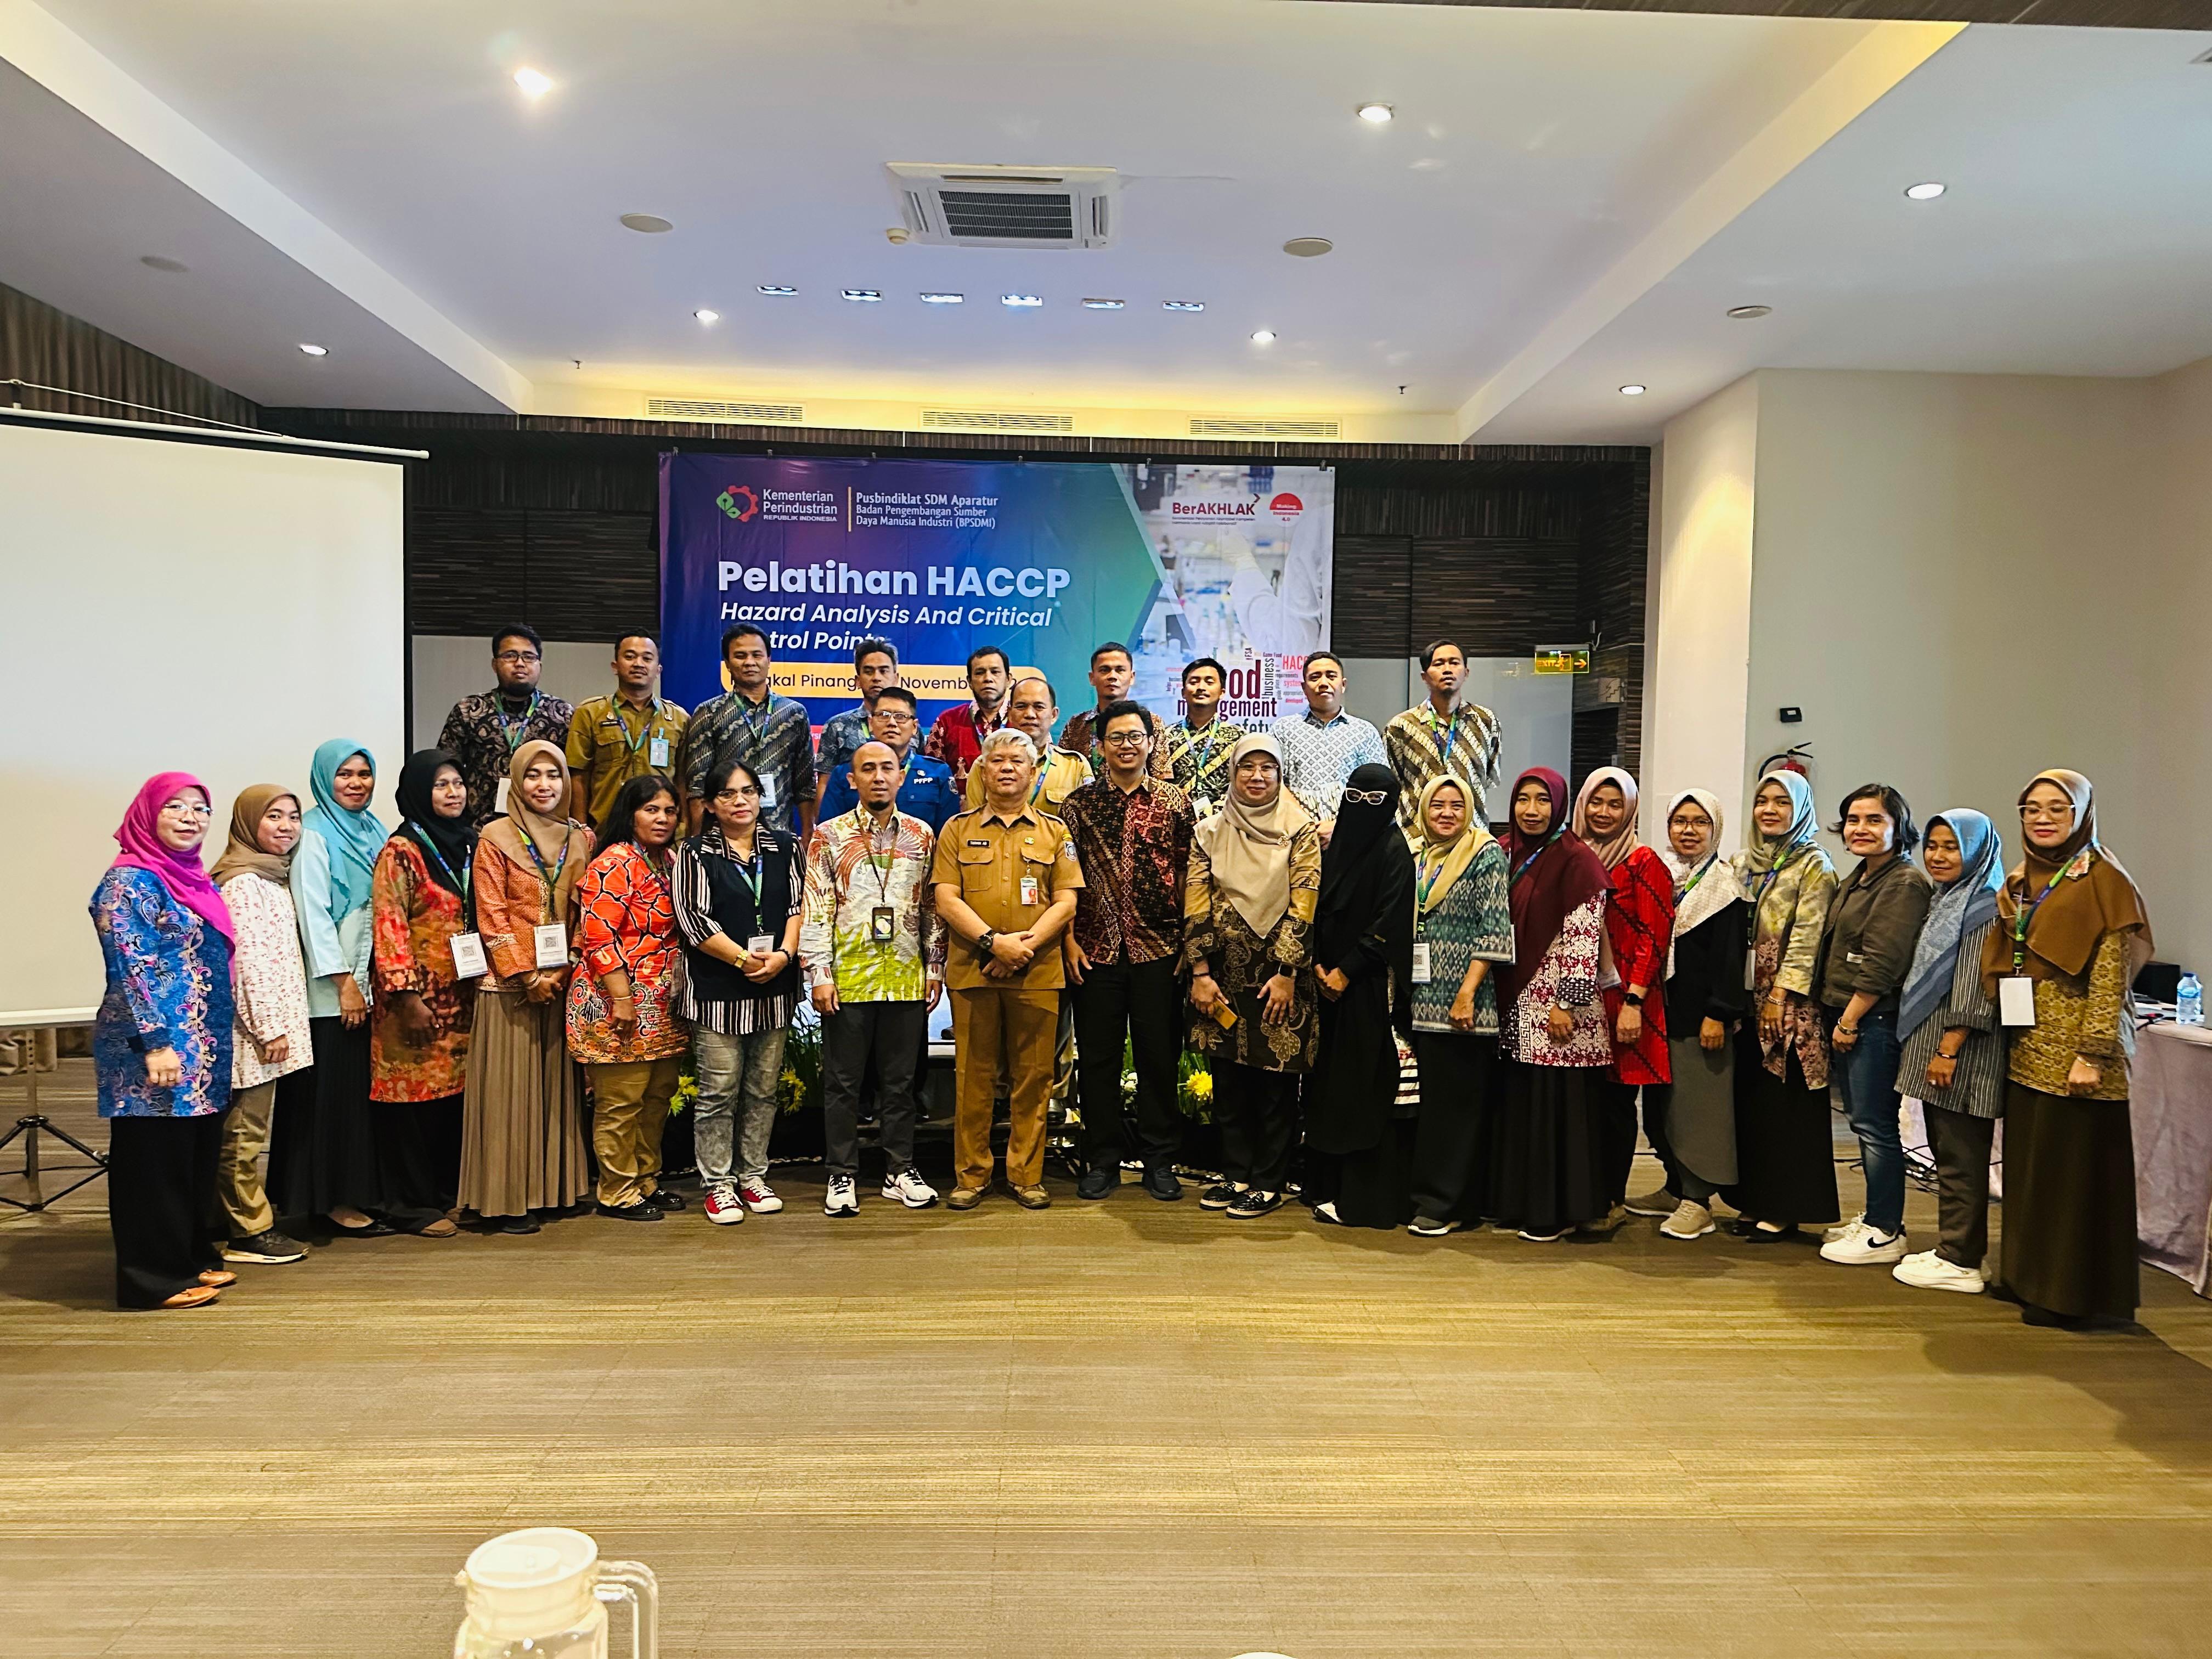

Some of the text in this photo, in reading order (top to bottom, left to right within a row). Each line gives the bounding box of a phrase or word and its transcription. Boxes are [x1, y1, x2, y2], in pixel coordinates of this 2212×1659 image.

[763, 489, 833, 502] Kementerian
[856, 492, 998, 509] Pusbindiklat SDM Aparatur
[763, 502, 837, 515] Perindustrian
[856, 504, 987, 518] Badan Pengembangan Sumber
[1172, 502, 1255, 515] BerAKHLAK
[856, 516, 996, 529] Daya Manusia Industri (BPSDMI)
[718, 559, 1070, 598] Pelatihan HACCP
[721, 602, 1051, 629] Hazard Analysis And Critical
[901, 676, 968, 690] Novemb
[1262, 658, 1274, 696] business
[1178, 697, 1277, 721] mgement
